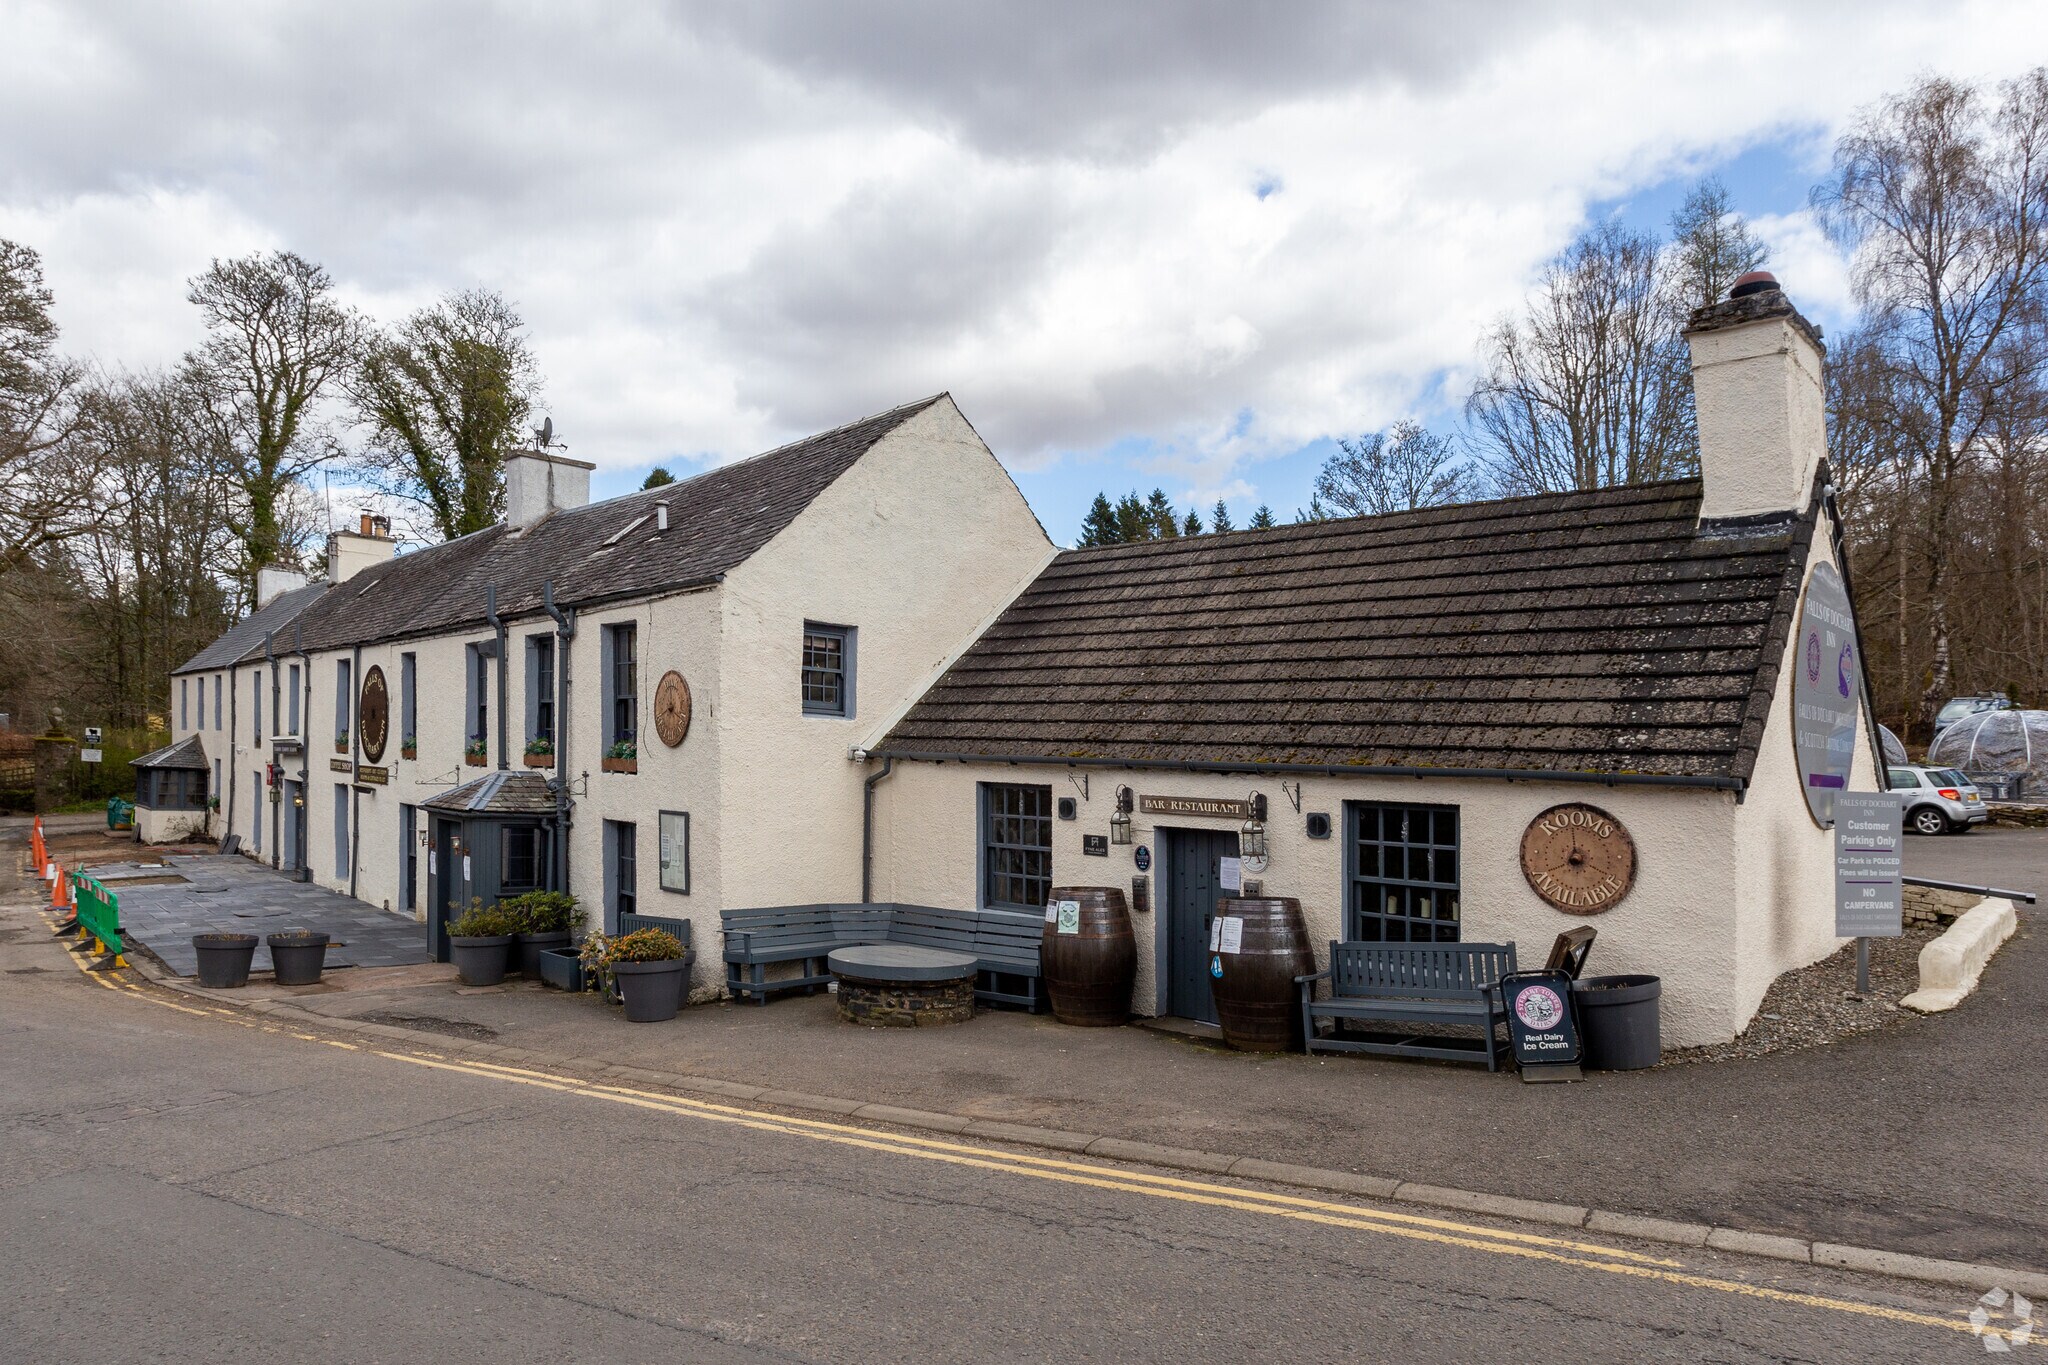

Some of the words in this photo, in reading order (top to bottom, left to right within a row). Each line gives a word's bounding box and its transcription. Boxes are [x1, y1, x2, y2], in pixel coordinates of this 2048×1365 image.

[1807, 598, 1823, 620] FALLS
[1823, 606, 1830, 623] OF
[1830, 610, 1853, 633] DOCHART
[1826, 630, 1836, 648] INN
[341, 762, 352, 771] SHOP
[1145, 799, 1166, 809] BAR
[1171, 801, 1241, 814] RESTAURANT
[1840, 799, 1859, 807] FALLS
[1868, 800, 1897, 808] DOCHART
[1539, 811, 1614, 838] ROOMS
[1847, 820, 1890, 831] Customer
[1841, 835, 1875, 848] Parking
[1876, 836, 1897, 848] Only
[1839, 868, 1856, 876] Fines
[1532, 871, 1623, 906] AVAILABLE
[1863, 888, 1876, 897] NO
[1844, 901, 1894, 909] CAMPERVANS
[1518, 988, 1540, 1011] STEWART
[1541, 988, 1561, 1009] TOWER
[1525, 1034, 1542, 1042] Real
[1544, 1033, 1564, 1041] Dairy
[1523, 1042, 1537, 1050] Ice
[1538, 1041, 1569, 1050] Cream
